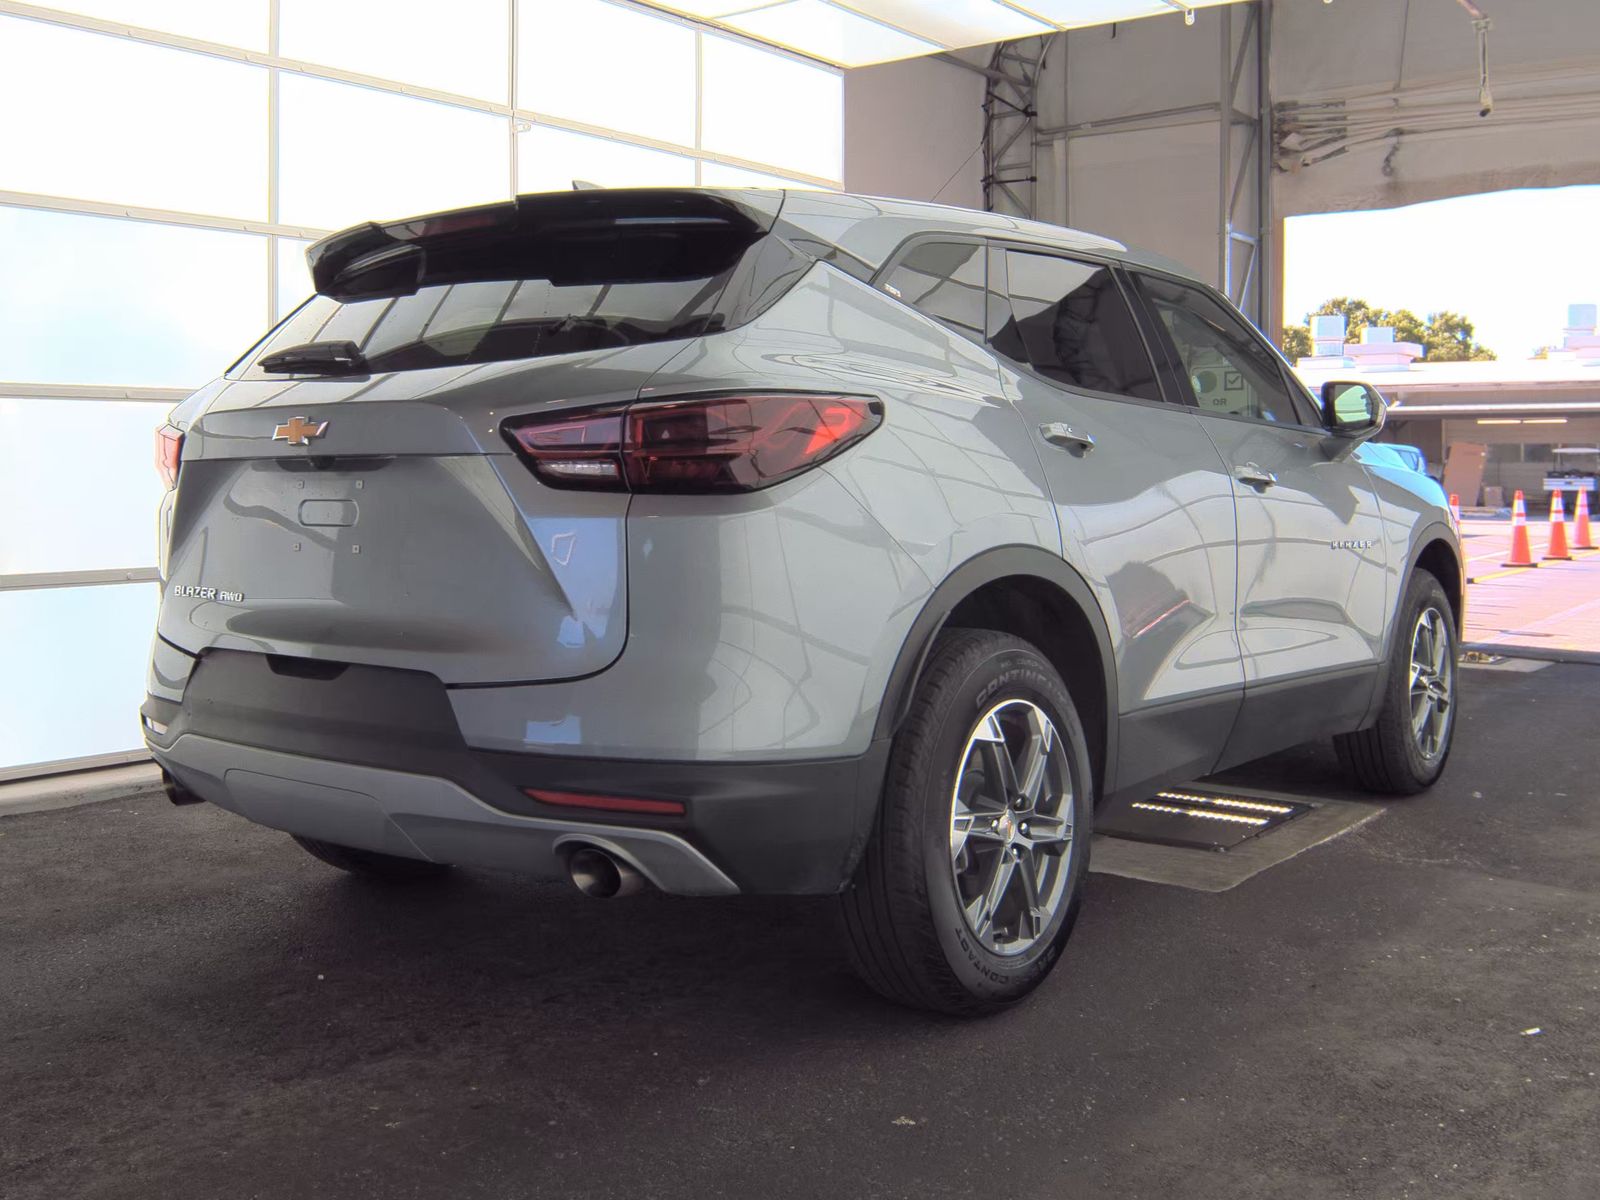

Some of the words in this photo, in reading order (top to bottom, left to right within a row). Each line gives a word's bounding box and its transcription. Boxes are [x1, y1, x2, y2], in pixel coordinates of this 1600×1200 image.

[1213, 398, 1227, 406] OR
[174, 585, 216, 600] BLAZER
[219, 591, 244, 602] AWD
